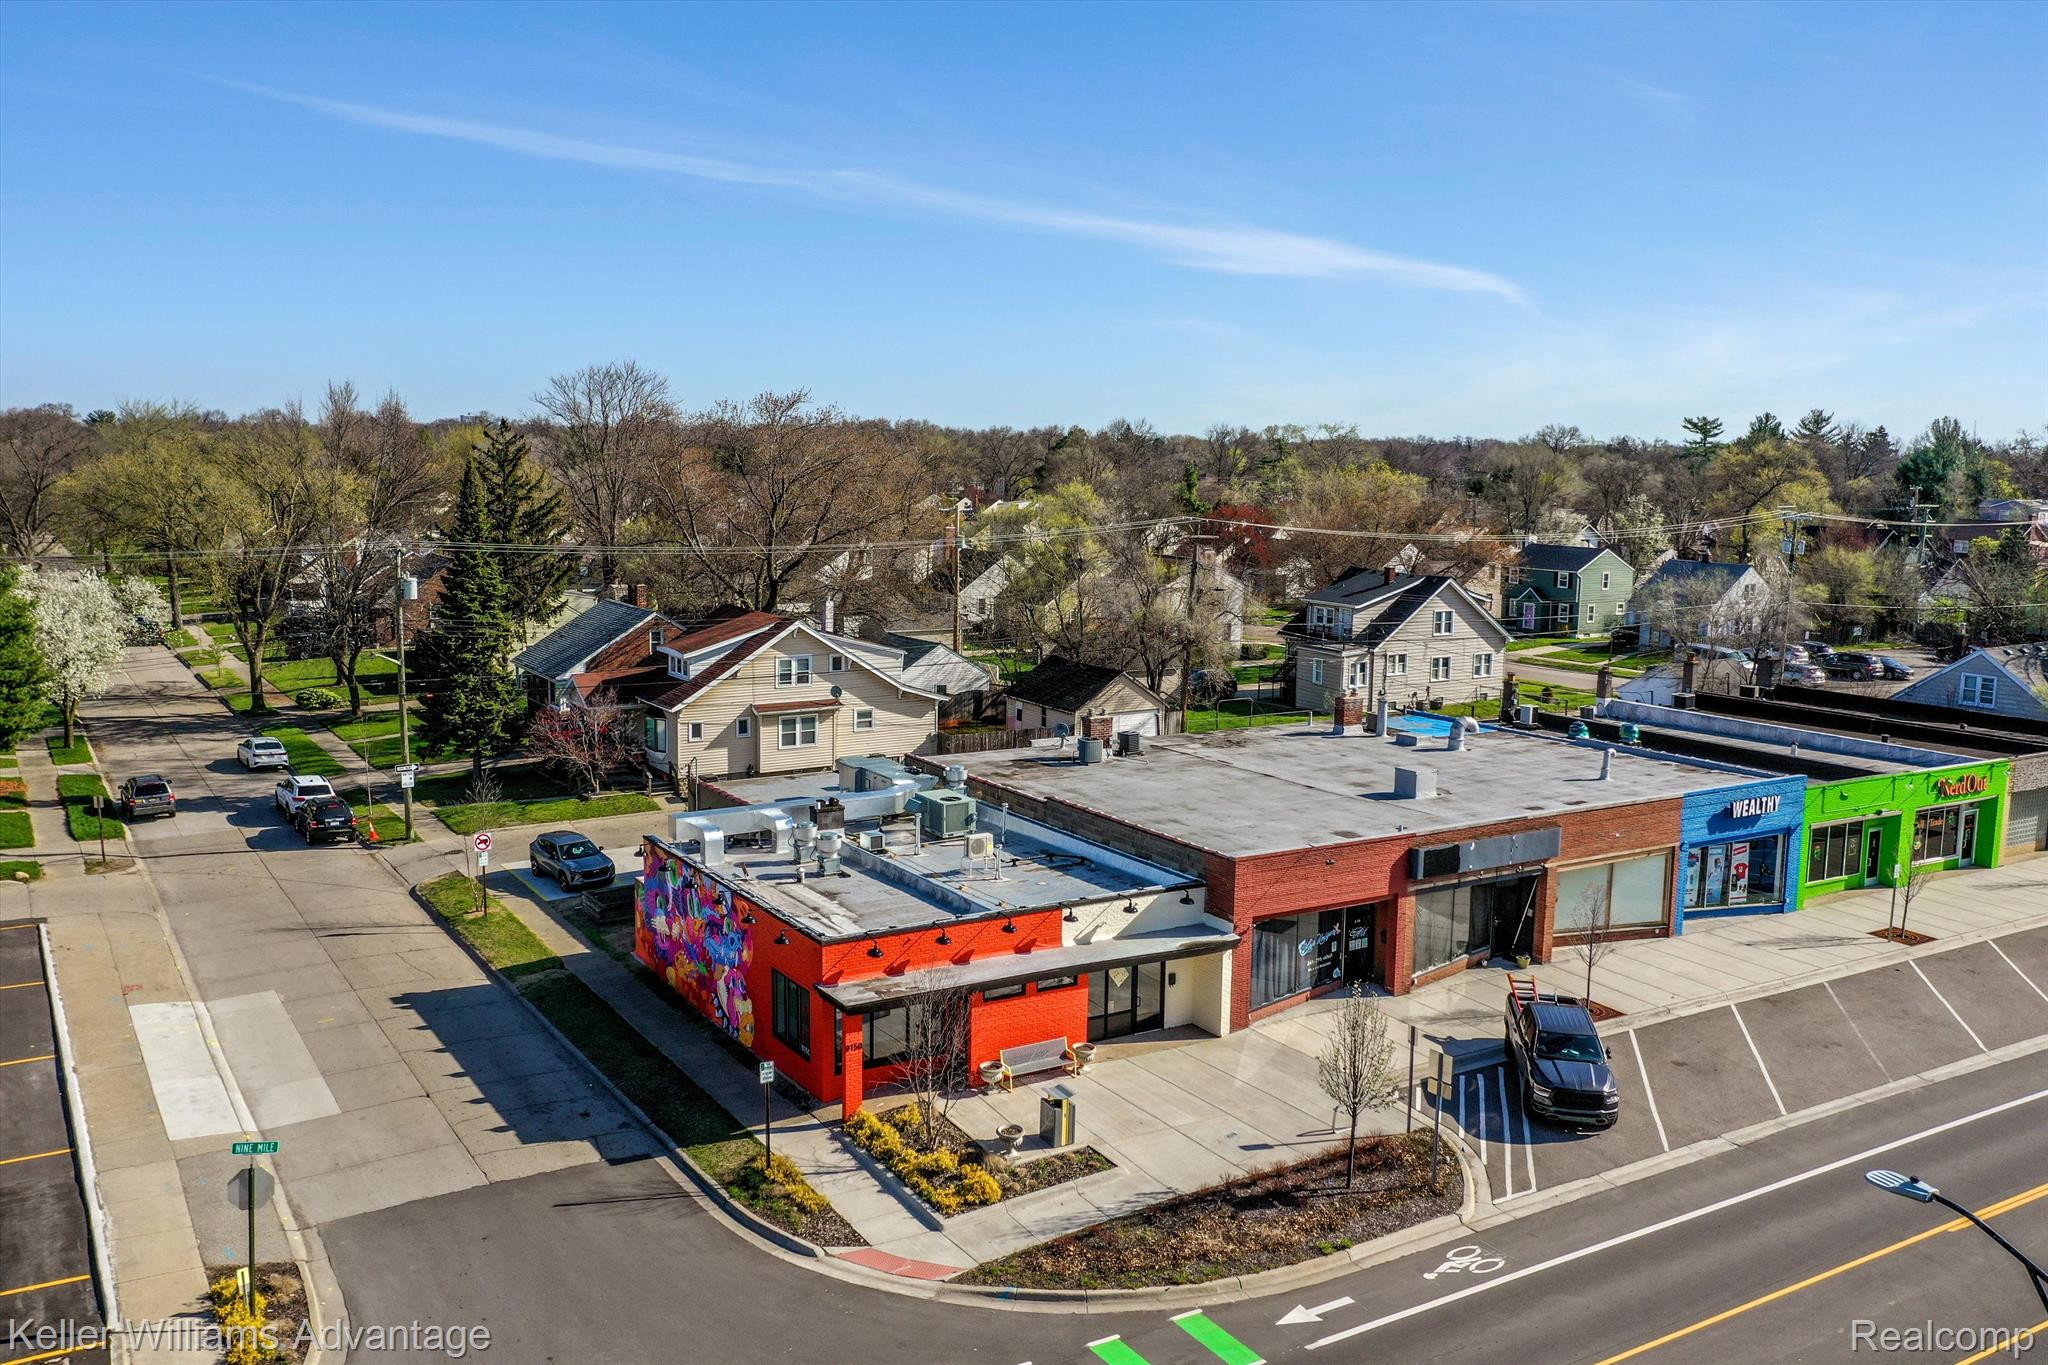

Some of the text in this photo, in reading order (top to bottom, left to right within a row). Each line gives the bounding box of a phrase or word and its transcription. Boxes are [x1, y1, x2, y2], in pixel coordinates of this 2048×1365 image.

[1732, 795, 1781, 818] WEALTHY
[845, 1042, 862, 1052] 9150
[235, 1142, 275, 1153] NINE MILE
